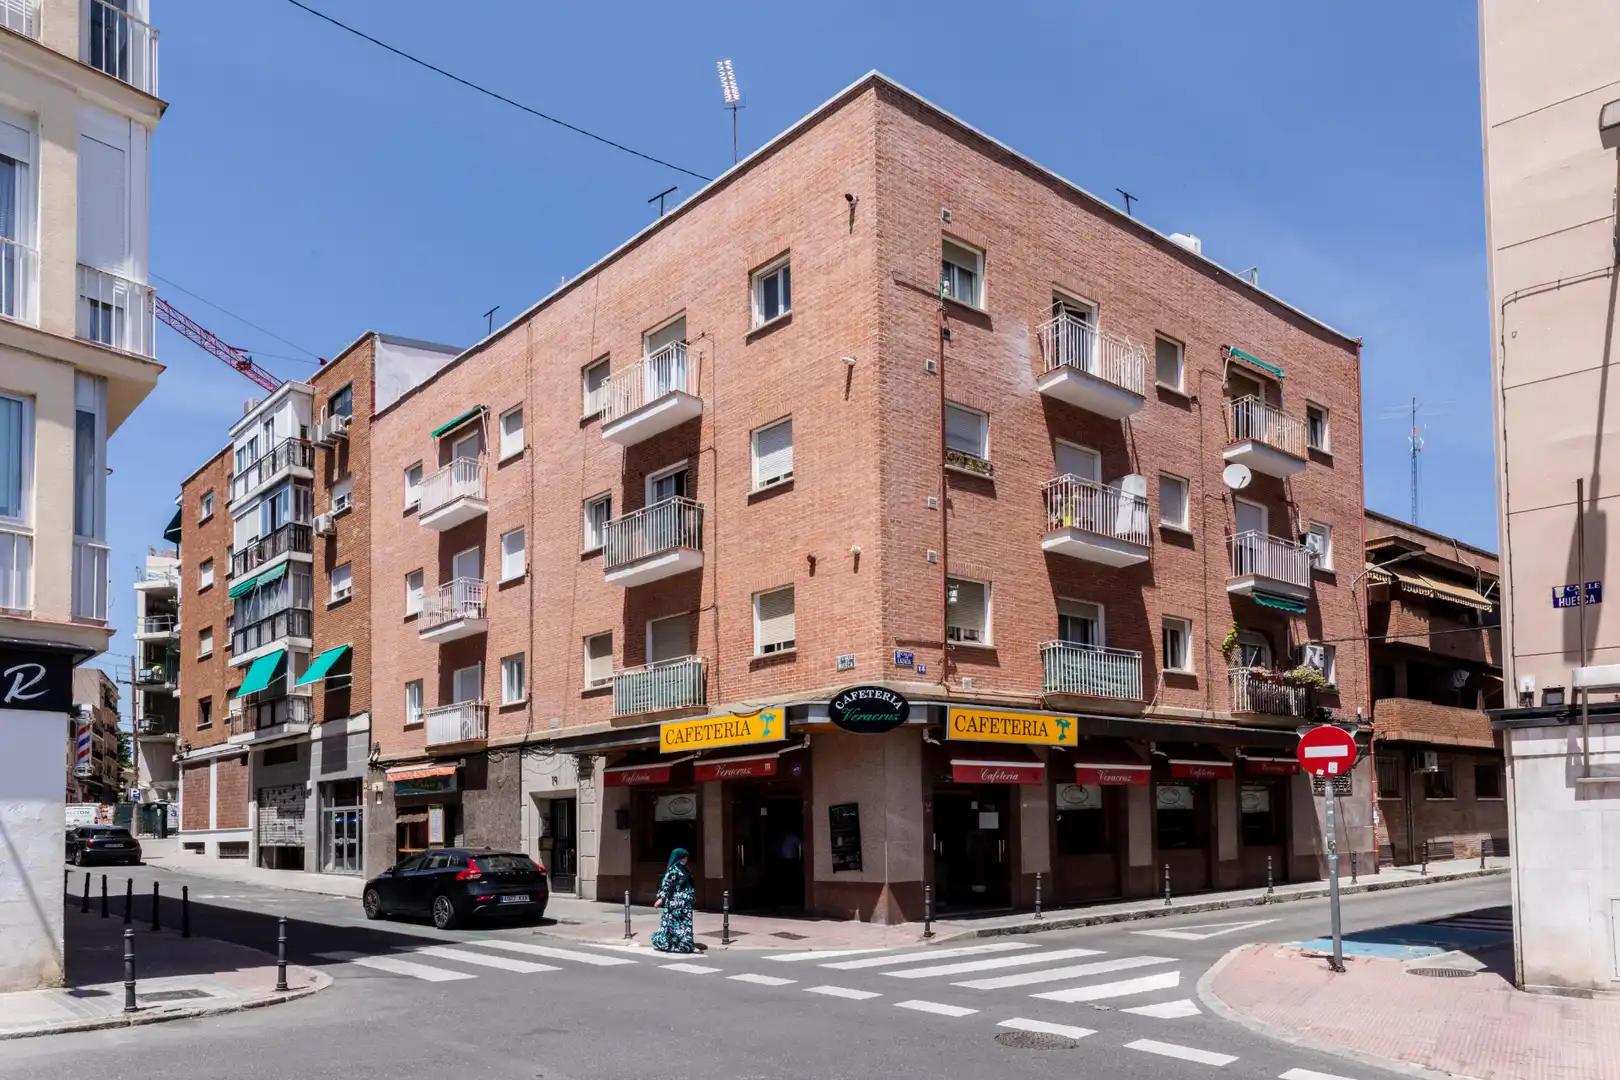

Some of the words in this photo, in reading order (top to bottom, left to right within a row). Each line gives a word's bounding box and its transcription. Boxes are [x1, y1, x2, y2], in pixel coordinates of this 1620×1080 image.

[4, 663, 50, 703] R
[835, 689, 903, 711] CAFETERIA
[841, 707, 901, 722] Veracruz
[954, 714, 1049, 737] CAFETERIA
[665, 719, 751, 745] CAFETERIA
[715, 763, 754, 777] Veracruz
[1097, 767, 1132, 783] Veracruz
